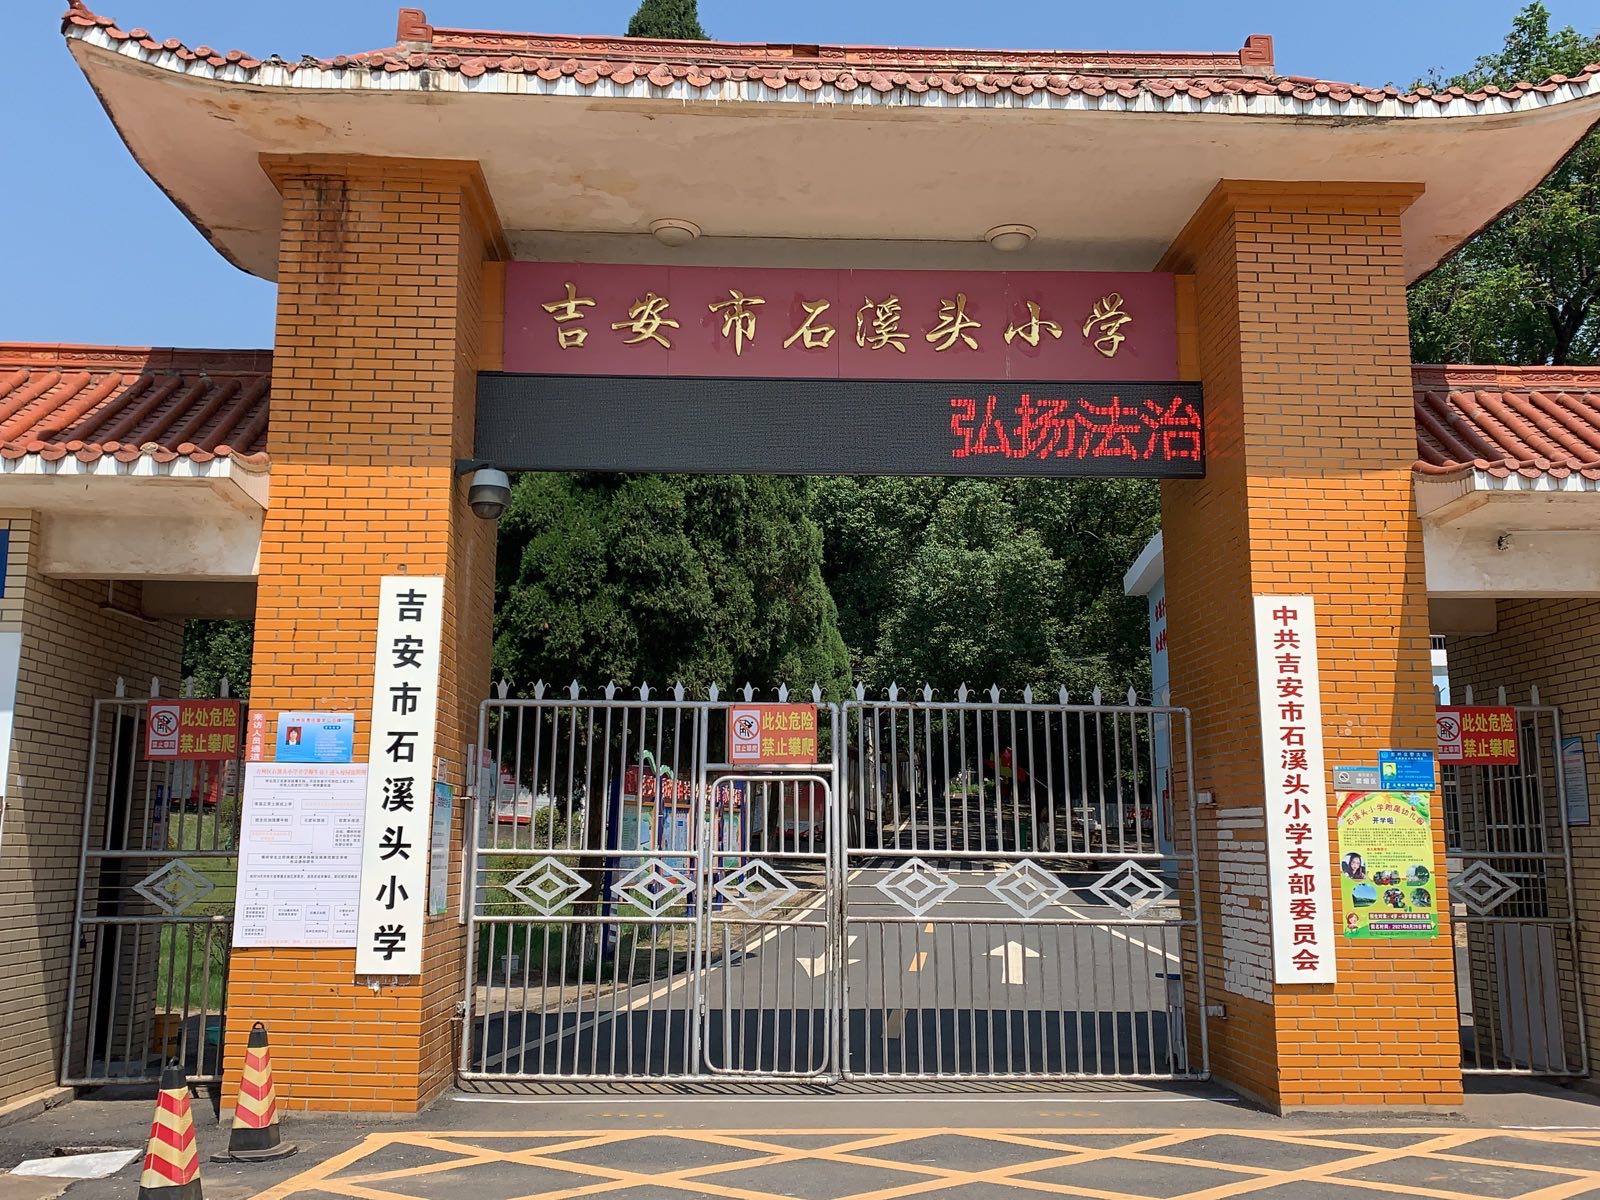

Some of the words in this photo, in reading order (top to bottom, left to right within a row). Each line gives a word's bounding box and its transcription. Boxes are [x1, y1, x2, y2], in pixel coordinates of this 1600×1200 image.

[542, 281, 1132, 357] 吉安市石溪头小学
[951, 395, 1203, 461] 弘扬法治
[182, 708, 236, 727] 此处危险
[762, 711, 814, 731] 此处危险
[1462, 713, 1514, 732] 此处危险
[181, 733, 235, 753] 禁止攀爬
[762, 737, 814, 757] 禁止攀爬
[1464, 738, 1516, 758] 禁止攀爬
[373, 588, 428, 961] 吉安市石溪头小学
[1273, 606, 1320, 970] 中共吉安市石溪头小学支部委员会
[1346, 803, 1425, 825] 石溪头小学附属幼儿园
